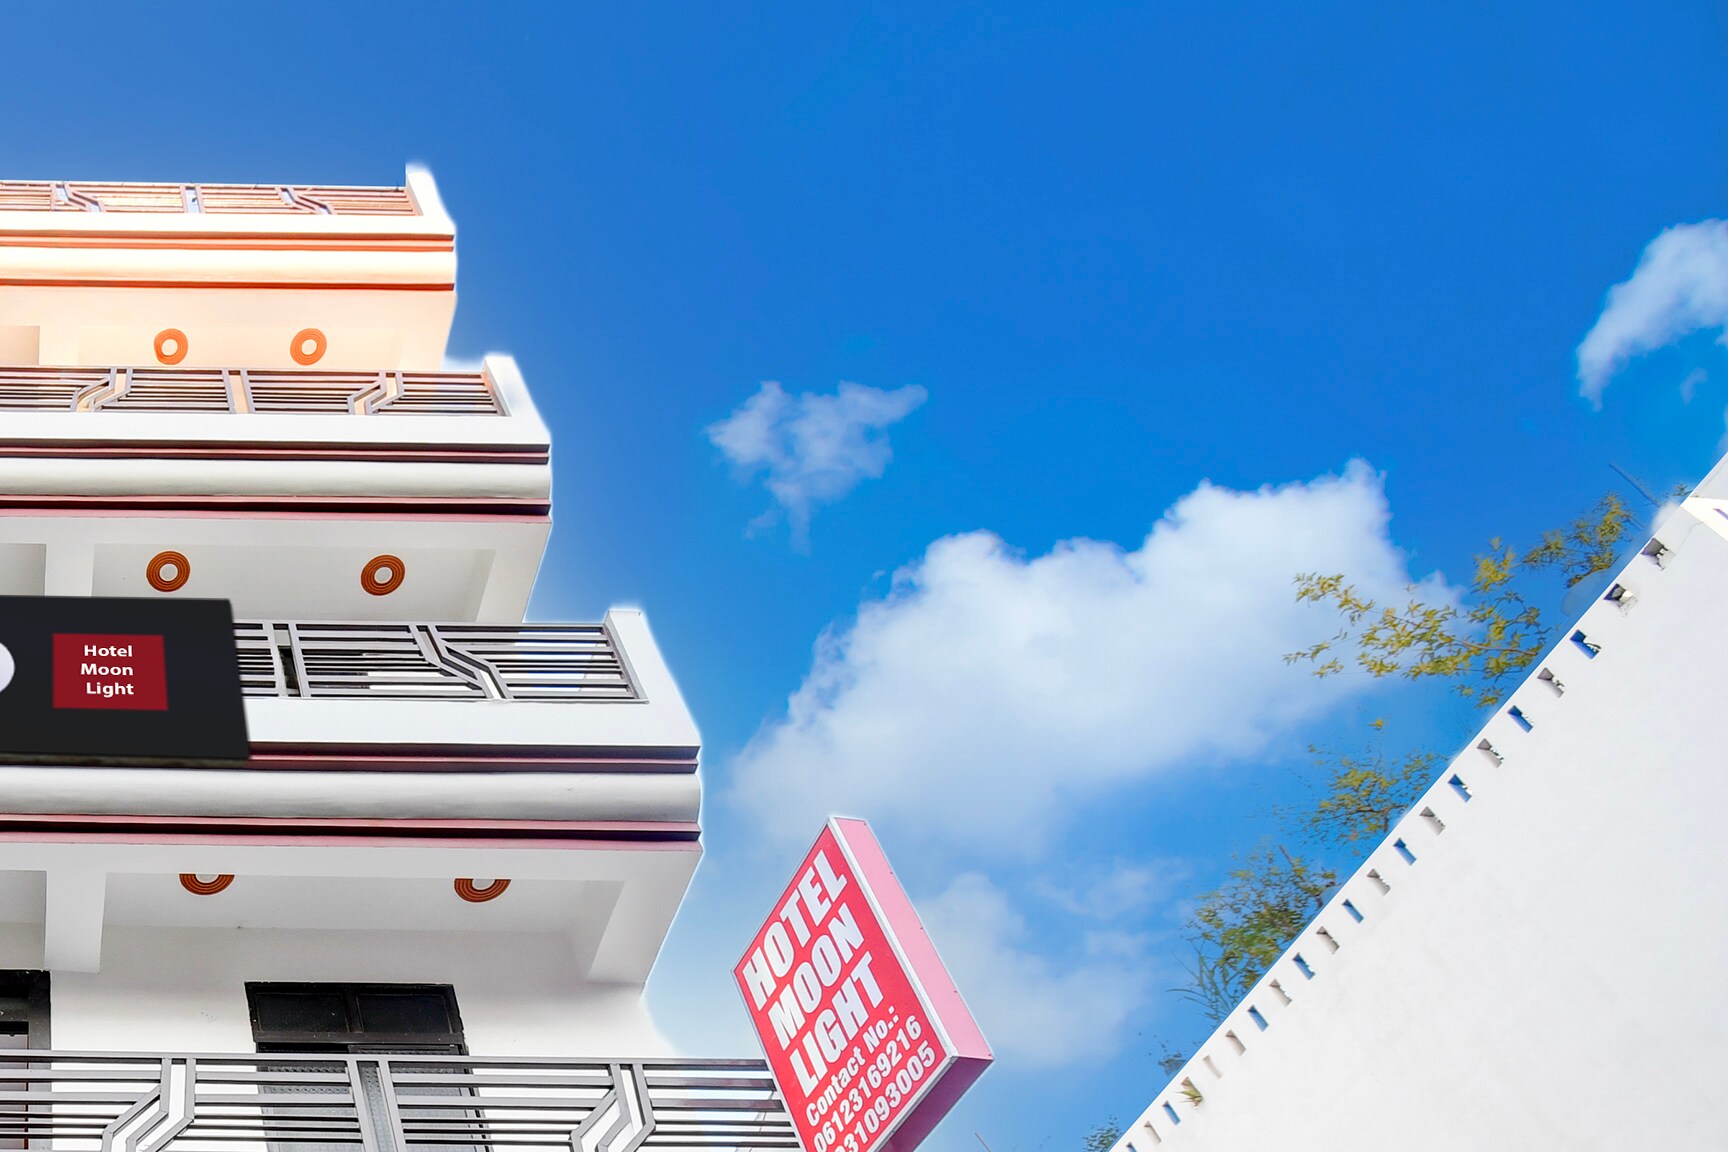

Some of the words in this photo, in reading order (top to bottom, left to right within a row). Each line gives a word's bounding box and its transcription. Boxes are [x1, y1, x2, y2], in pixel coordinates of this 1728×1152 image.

[80, 663, 134, 676] Moon
[84, 645, 133, 657] Hotel
[86, 682, 134, 698] Light
[742, 850, 847, 1011] HOTEL
[768, 903, 864, 1050] MOON
[790, 951, 883, 1097] LIGHT
[806, 1046, 866, 1127] Contact
